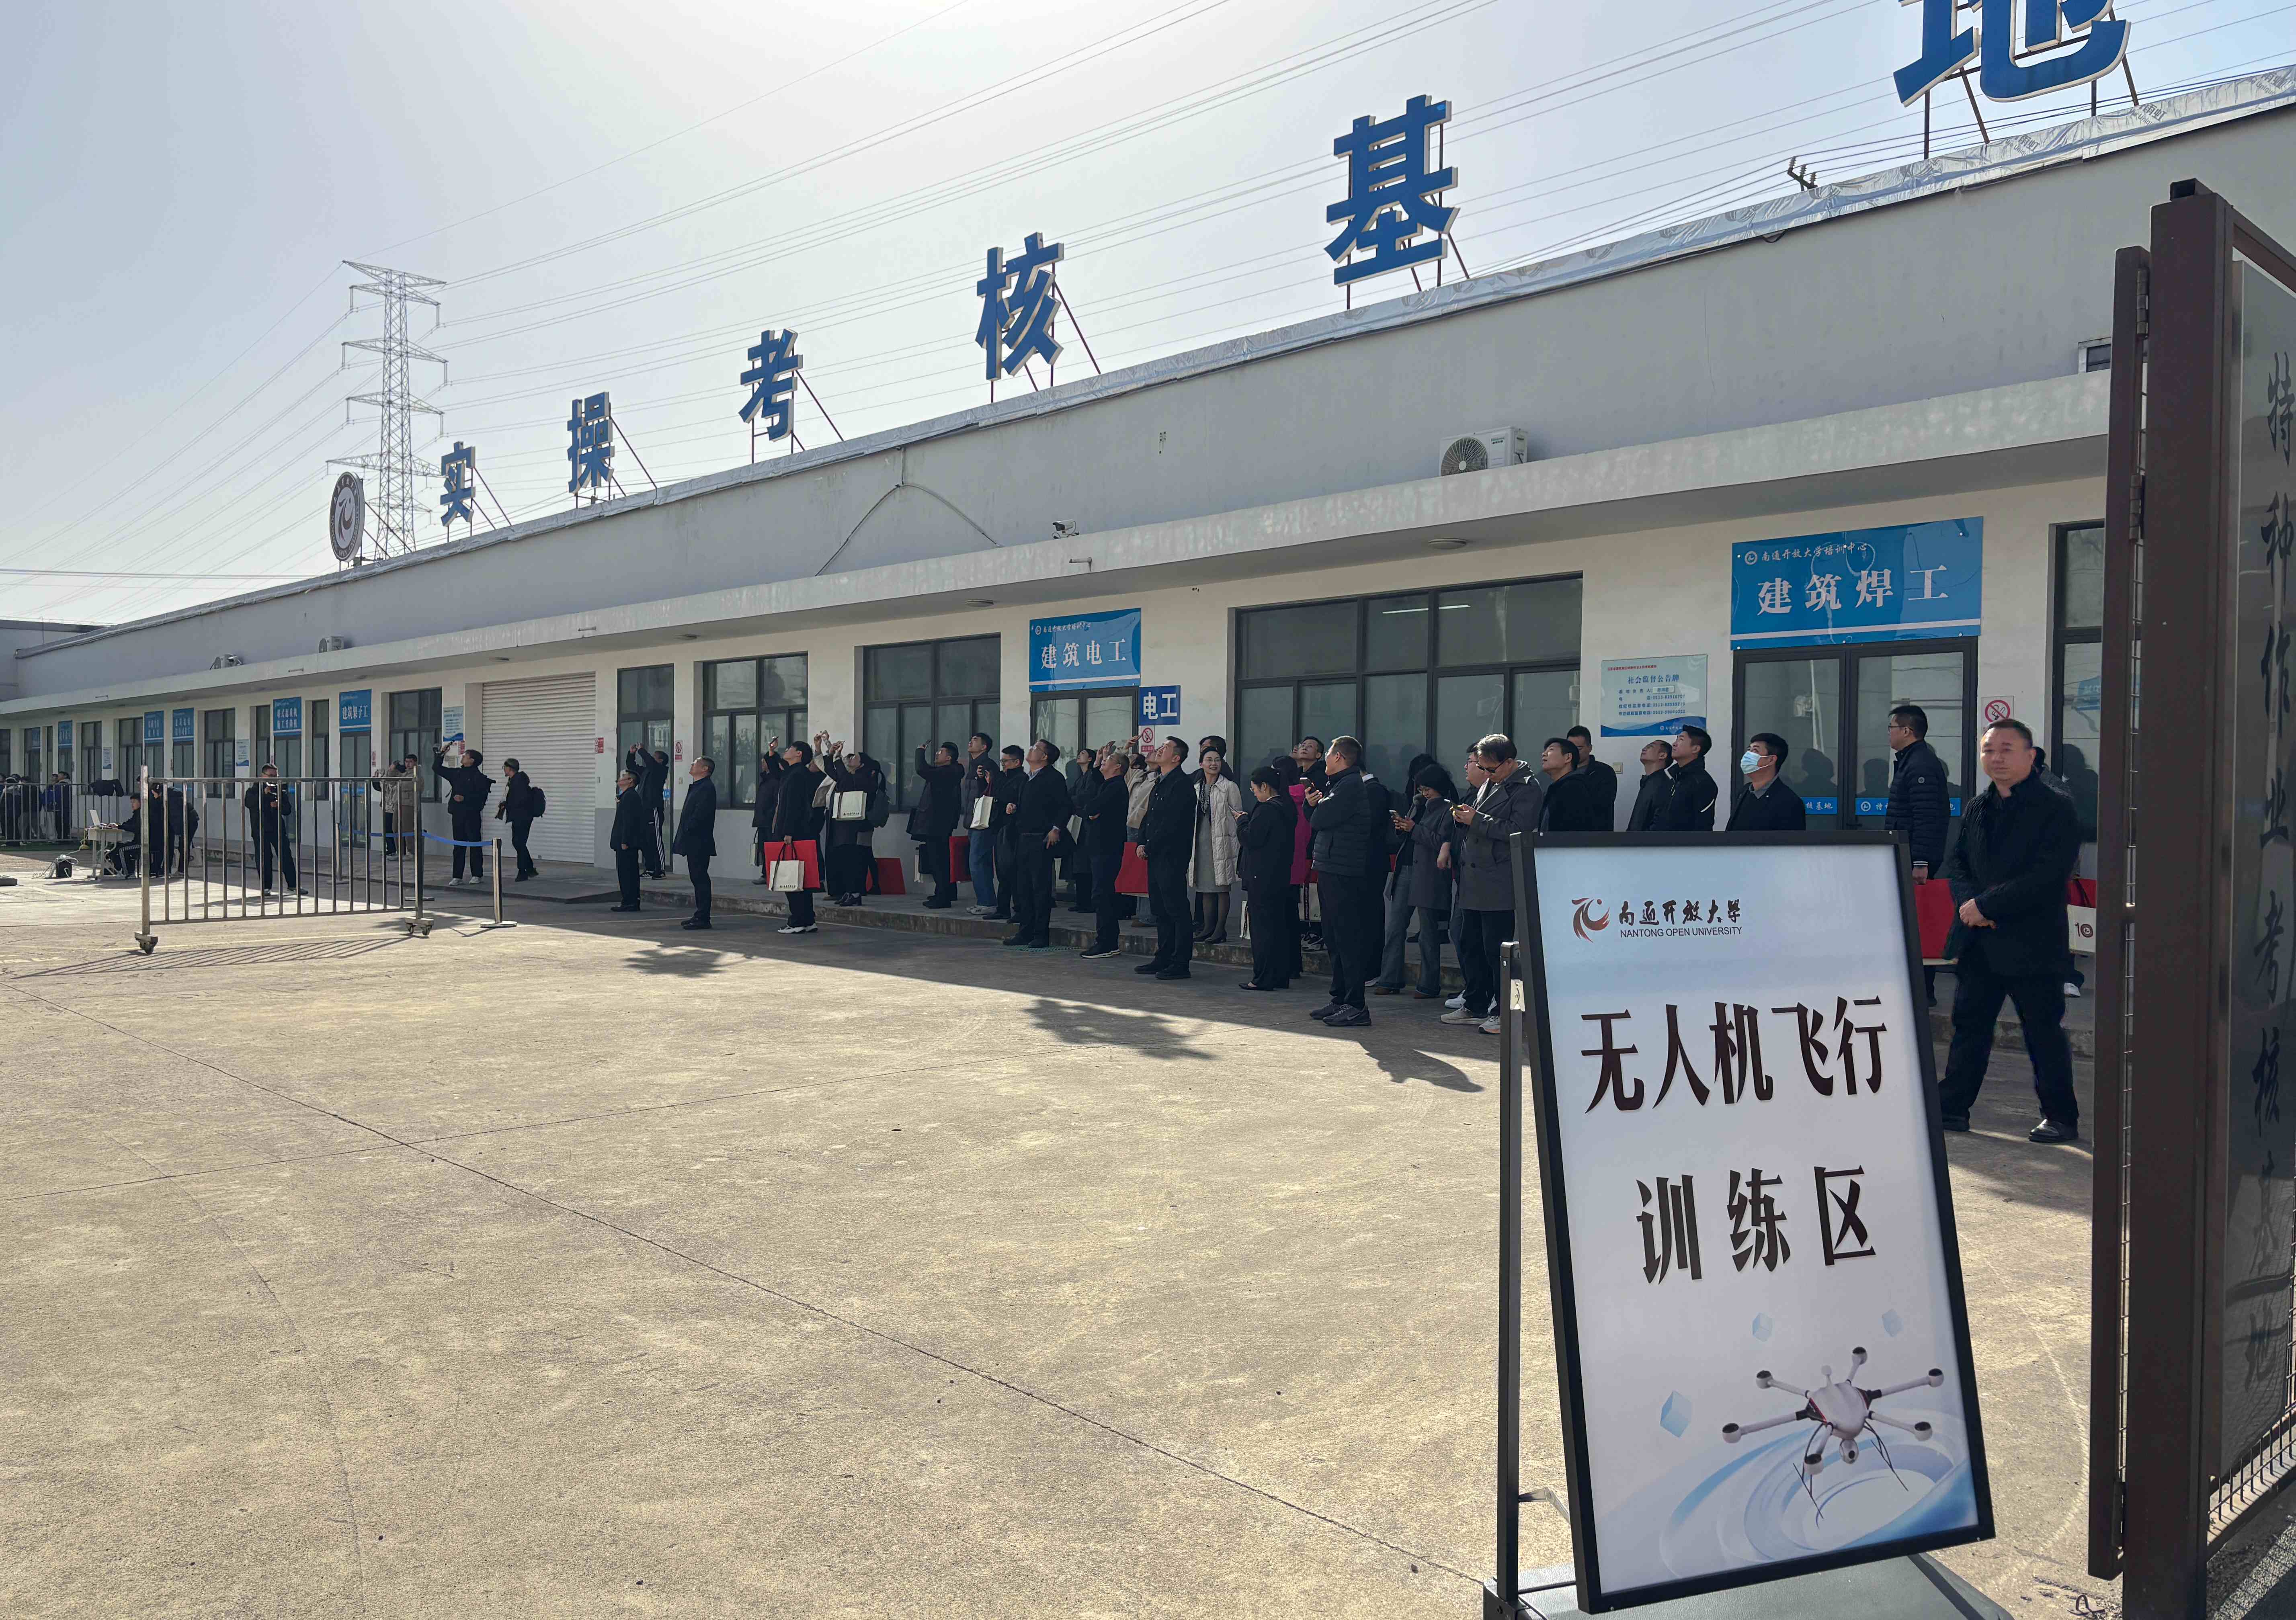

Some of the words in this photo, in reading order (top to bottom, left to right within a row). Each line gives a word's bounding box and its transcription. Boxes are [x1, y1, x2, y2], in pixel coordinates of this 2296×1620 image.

[1762, 542, 1867, 561] 南通开放大学培训中心
[1757, 564, 1948, 616] 建筑焊工
[1041, 638, 1126, 669] 建筑电工
[1143, 692, 1177, 720] 电工
[1619, 899, 1740, 926] 南通开放大学
[1620, 928, 1664, 938] NANTONG
[1666, 928, 1690, 936] OPEN
[1692, 926, 1742, 936] UNIVERSITY
[1580, 995, 1888, 1114] 无人机飞行
[1635, 1165, 1877, 1285] 训练区
